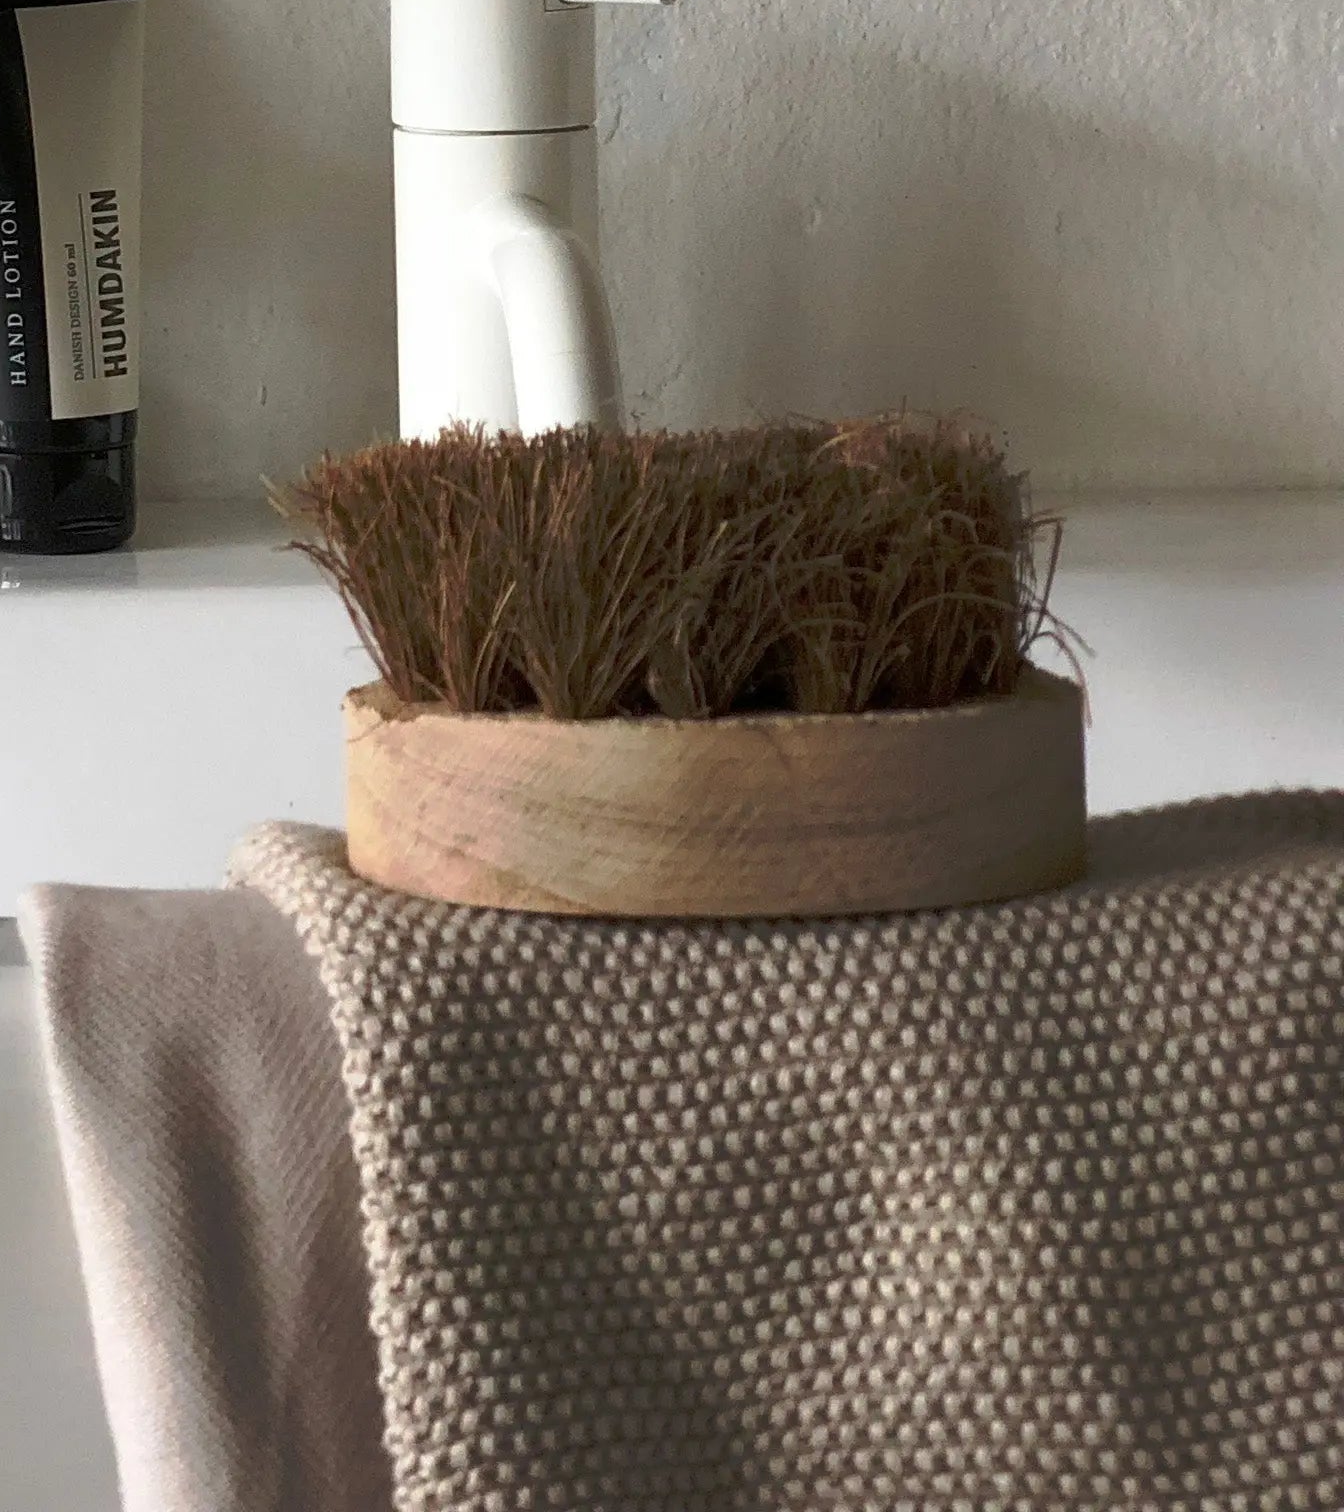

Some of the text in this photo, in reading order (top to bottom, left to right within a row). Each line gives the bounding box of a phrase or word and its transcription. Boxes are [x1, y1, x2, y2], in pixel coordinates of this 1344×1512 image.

[0, 200, 27, 385] HAND LOTION
[64, 244, 85, 381] DANISH DESIGN 60 ml
[89, 190, 128, 378] HUMDAKIN
